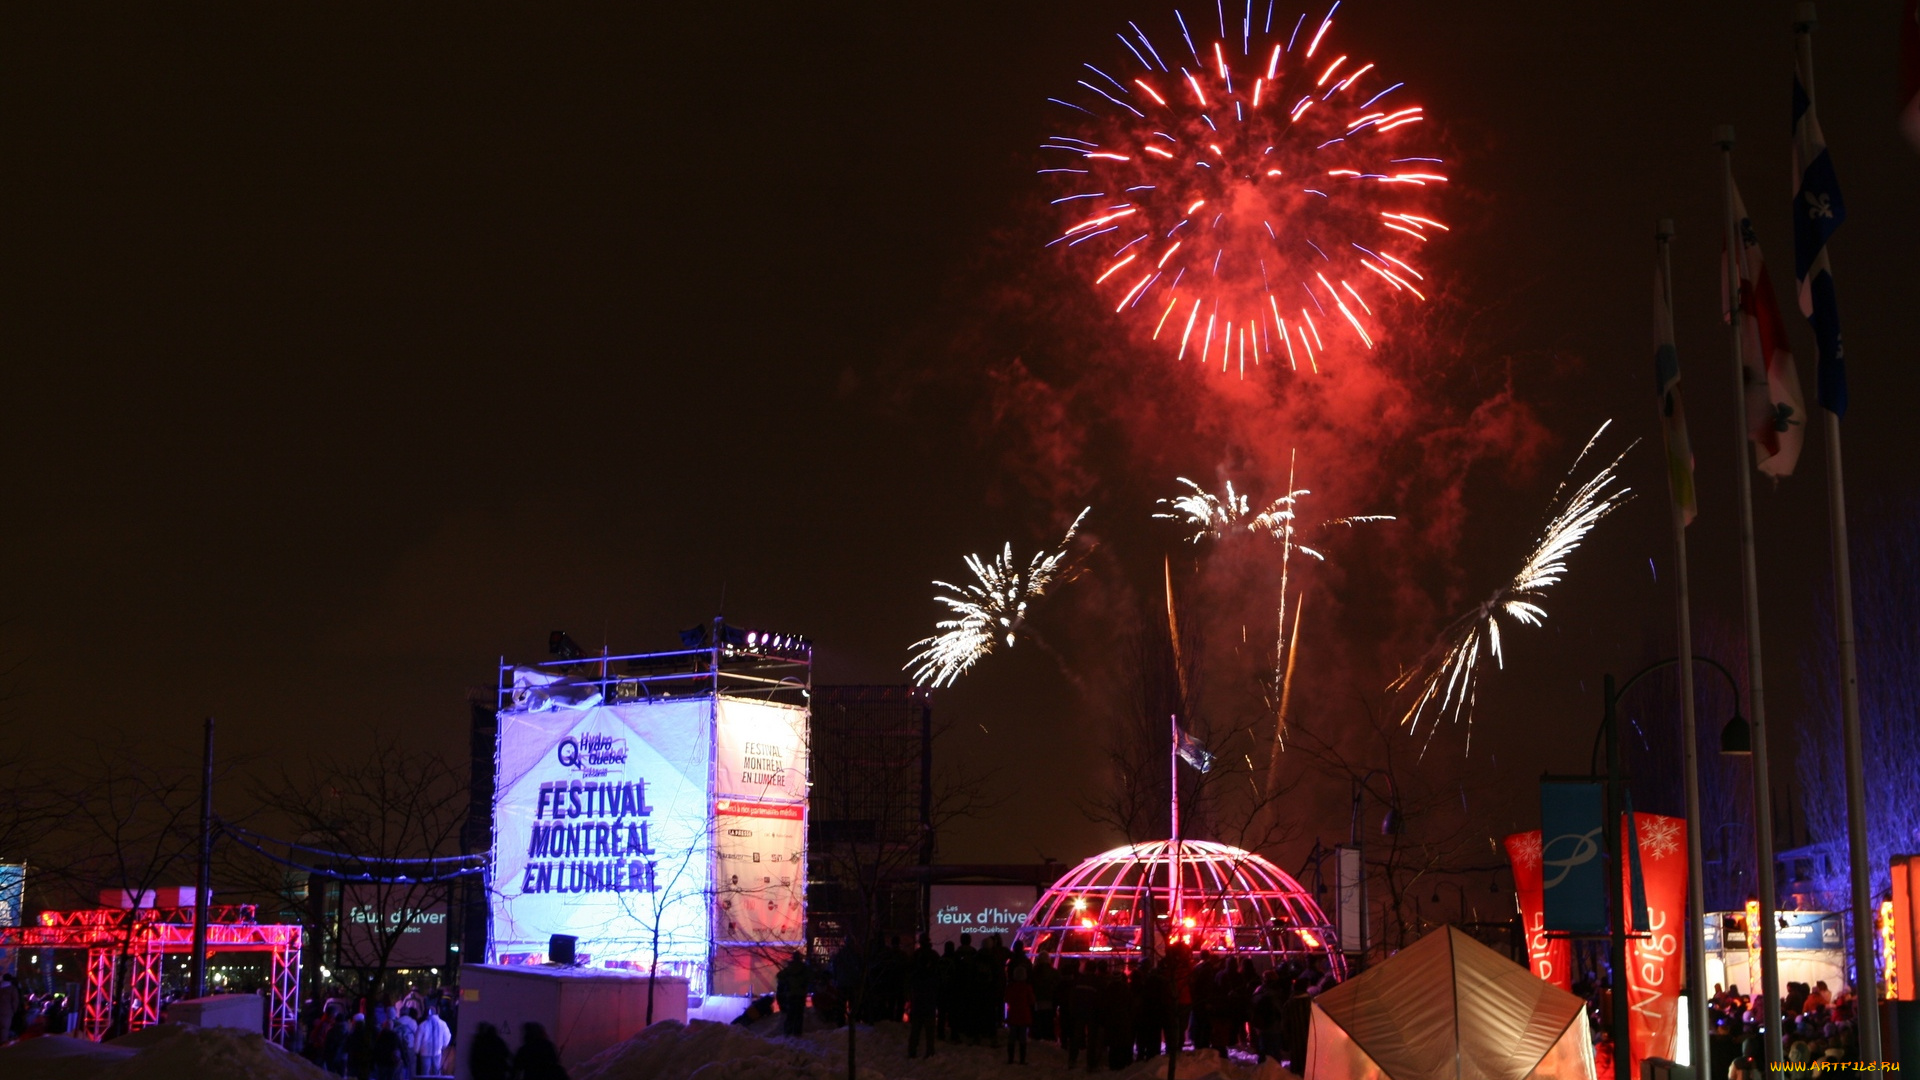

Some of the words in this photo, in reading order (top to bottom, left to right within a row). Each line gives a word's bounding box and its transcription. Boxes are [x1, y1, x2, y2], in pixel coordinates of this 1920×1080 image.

[580, 733, 613, 753] Hydro
[745, 742, 783, 758] FESTIVAL
[742, 771, 752, 783] EN
[536, 778, 653, 819] FESTIVAL
[529, 819, 655, 858] MONTRÉAL
[522, 861, 553, 894] EN
[556, 858, 662, 893] LUMIÈRE
[937, 910, 972, 924] feux
[977, 908, 1029, 924] d'hive
[1631, 907, 1677, 1018] Neige
